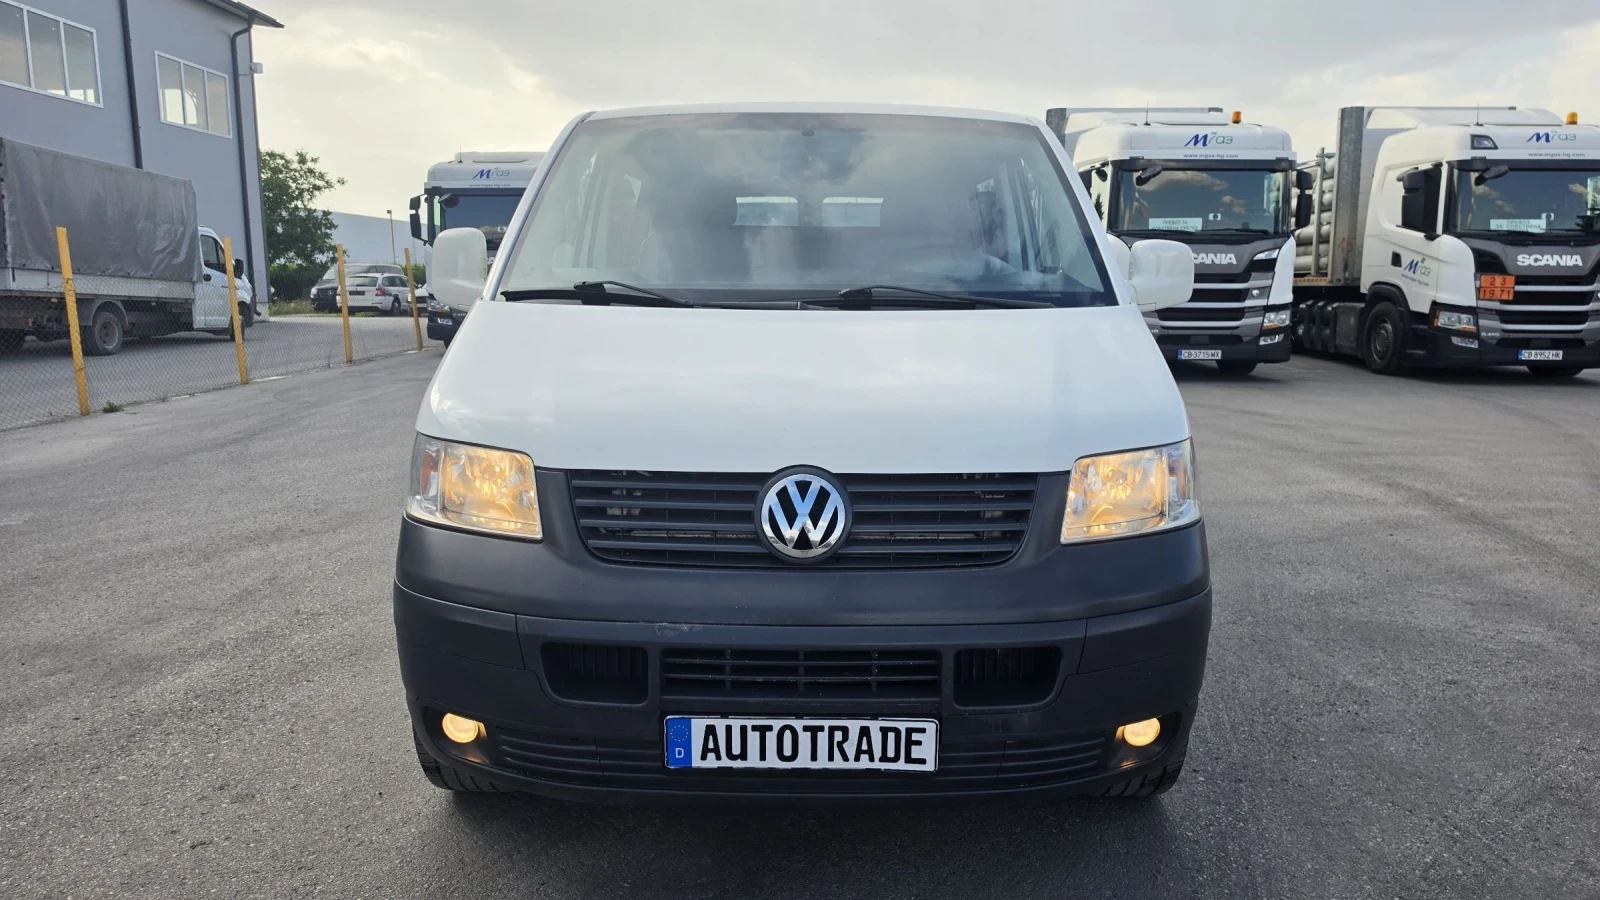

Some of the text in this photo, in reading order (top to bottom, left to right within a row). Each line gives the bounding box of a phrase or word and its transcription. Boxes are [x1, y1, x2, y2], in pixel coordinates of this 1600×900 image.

[1191, 253, 1237, 265] CANIA
[1516, 254, 1583, 267] SCANIA
[675, 724, 927, 765] D AUTOTRADE
